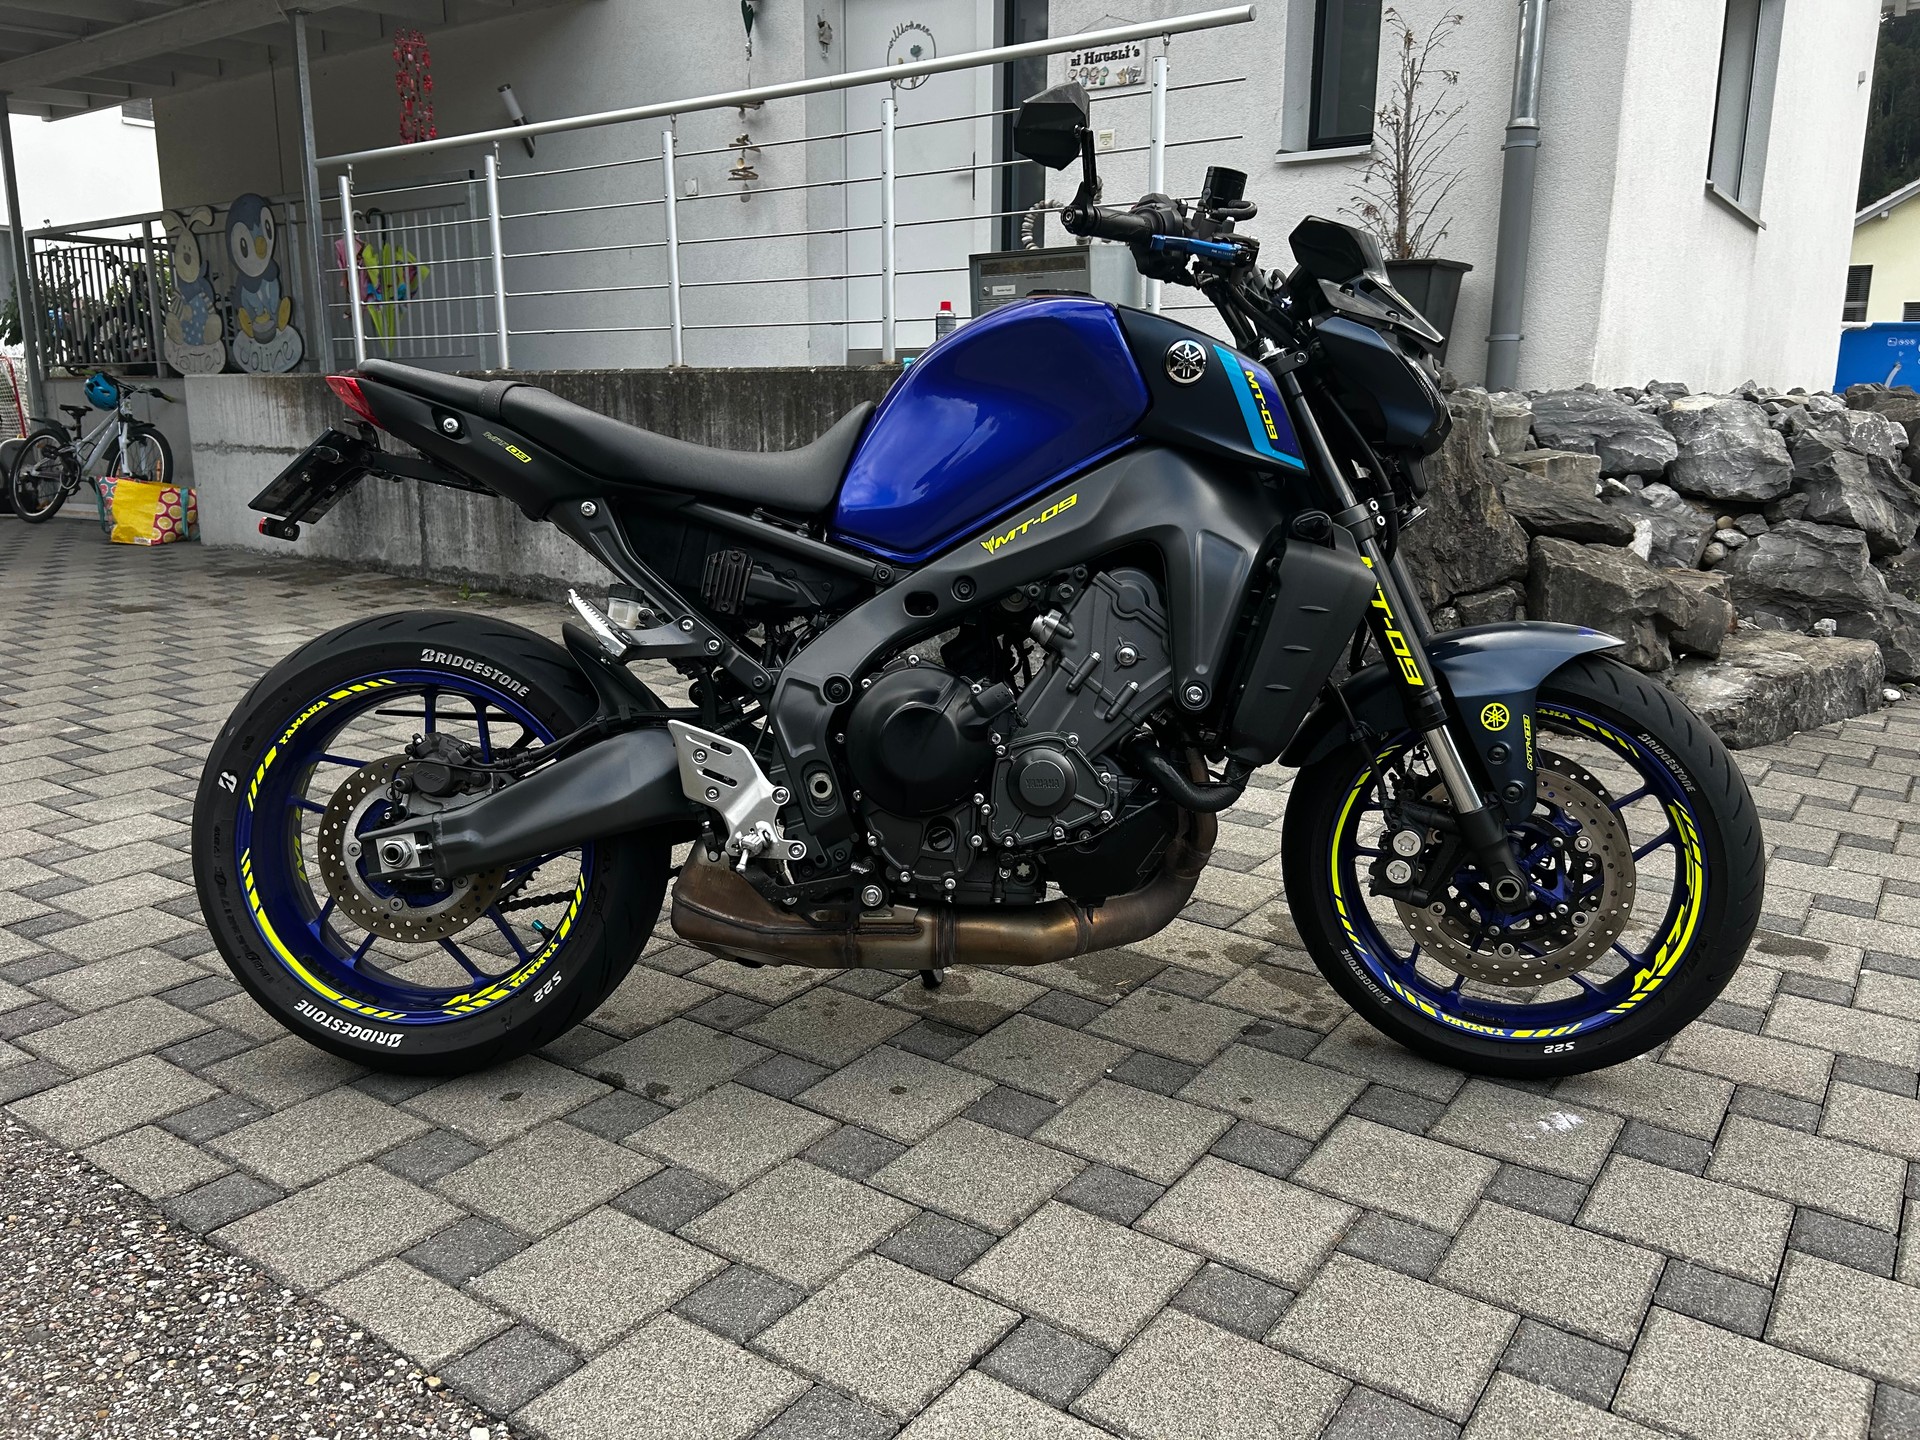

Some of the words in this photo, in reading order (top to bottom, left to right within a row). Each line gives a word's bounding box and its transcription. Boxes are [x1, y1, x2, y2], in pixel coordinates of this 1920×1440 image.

[1244, 370, 1279, 440] MT-09
[994, 493, 1078, 550] MT-09
[420, 648, 530, 697] BRIDGESTONE
[278, 700, 329, 745] YAMAHA
[1637, 733, 1697, 793] BRIDGESTONE
[509, 942, 560, 988] YAMAHA
[533, 970, 562, 1003] S22
[1340, 948, 1393, 1004] BRIDGESTONE
[293, 999, 405, 1048] BRIDGESTONE
[1441, 1013, 1506, 1037] YAMAHA
[1544, 1041, 1576, 1054] S22
